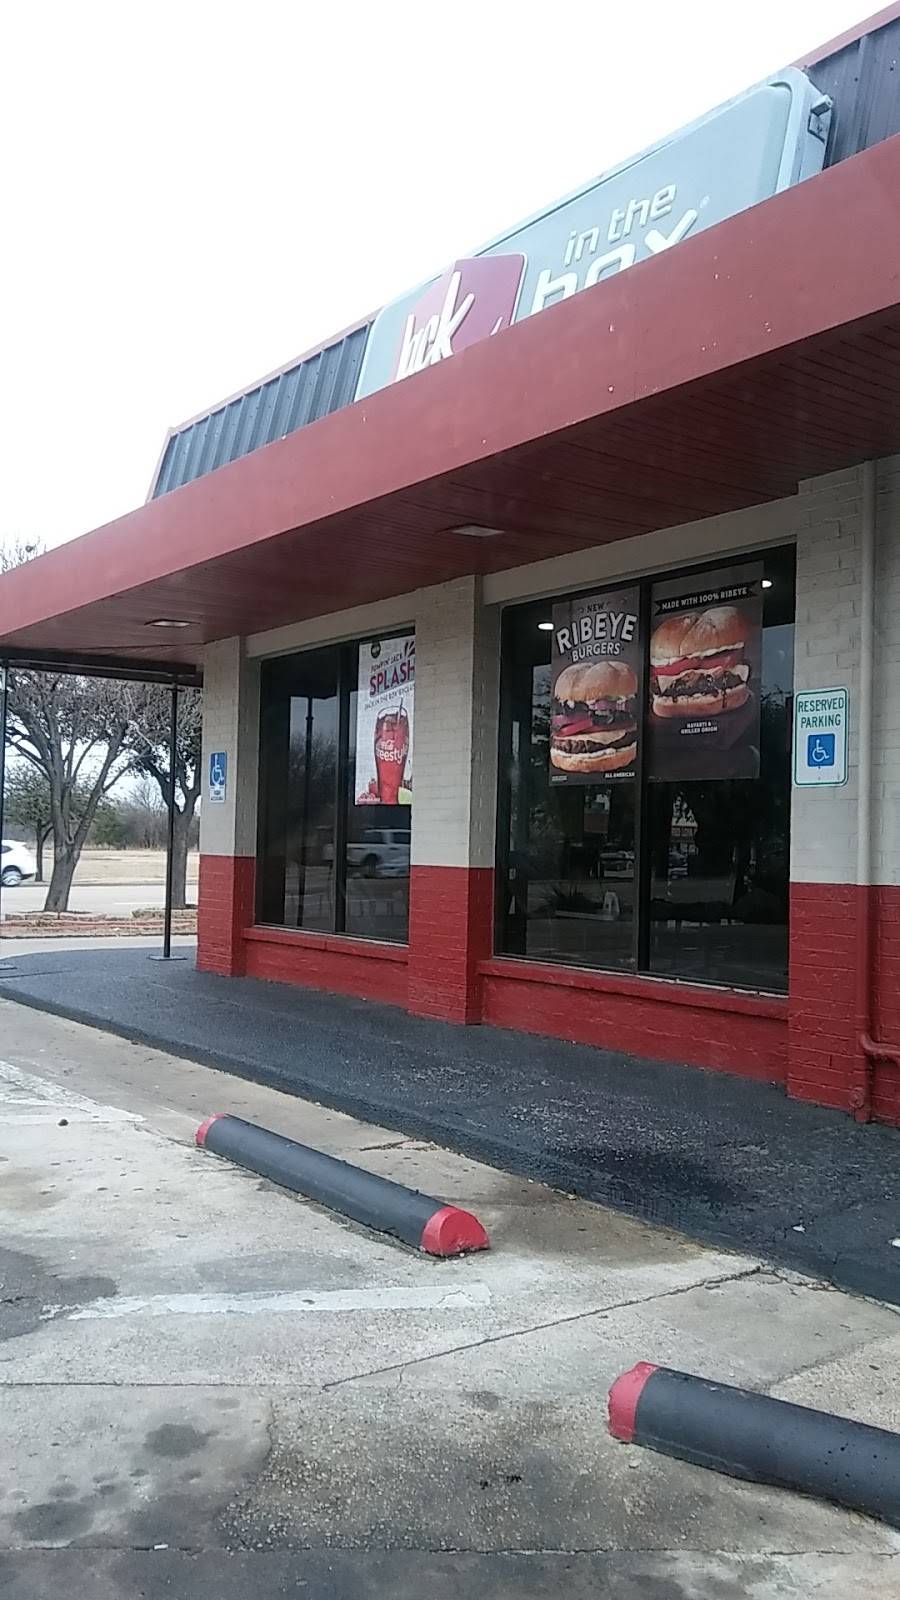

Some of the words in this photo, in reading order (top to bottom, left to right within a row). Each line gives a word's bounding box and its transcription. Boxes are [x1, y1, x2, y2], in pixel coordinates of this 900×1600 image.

[564, 227, 599, 266] in
[607, 184, 676, 243] the
[587, 602, 604, 613] NEW
[661, 601, 679, 610] MADE
[681, 596, 698, 606] WITH
[700, 592, 719, 602] 100%
[721, 587, 747, 598] RIBEYE
[556, 612, 638, 655] RIBEYE
[572, 642, 621, 662] BURGERS
[370, 659, 415, 697] SPLASH
[798, 697, 845, 713] RESERVED
[801, 714, 841, 729] PARKING
